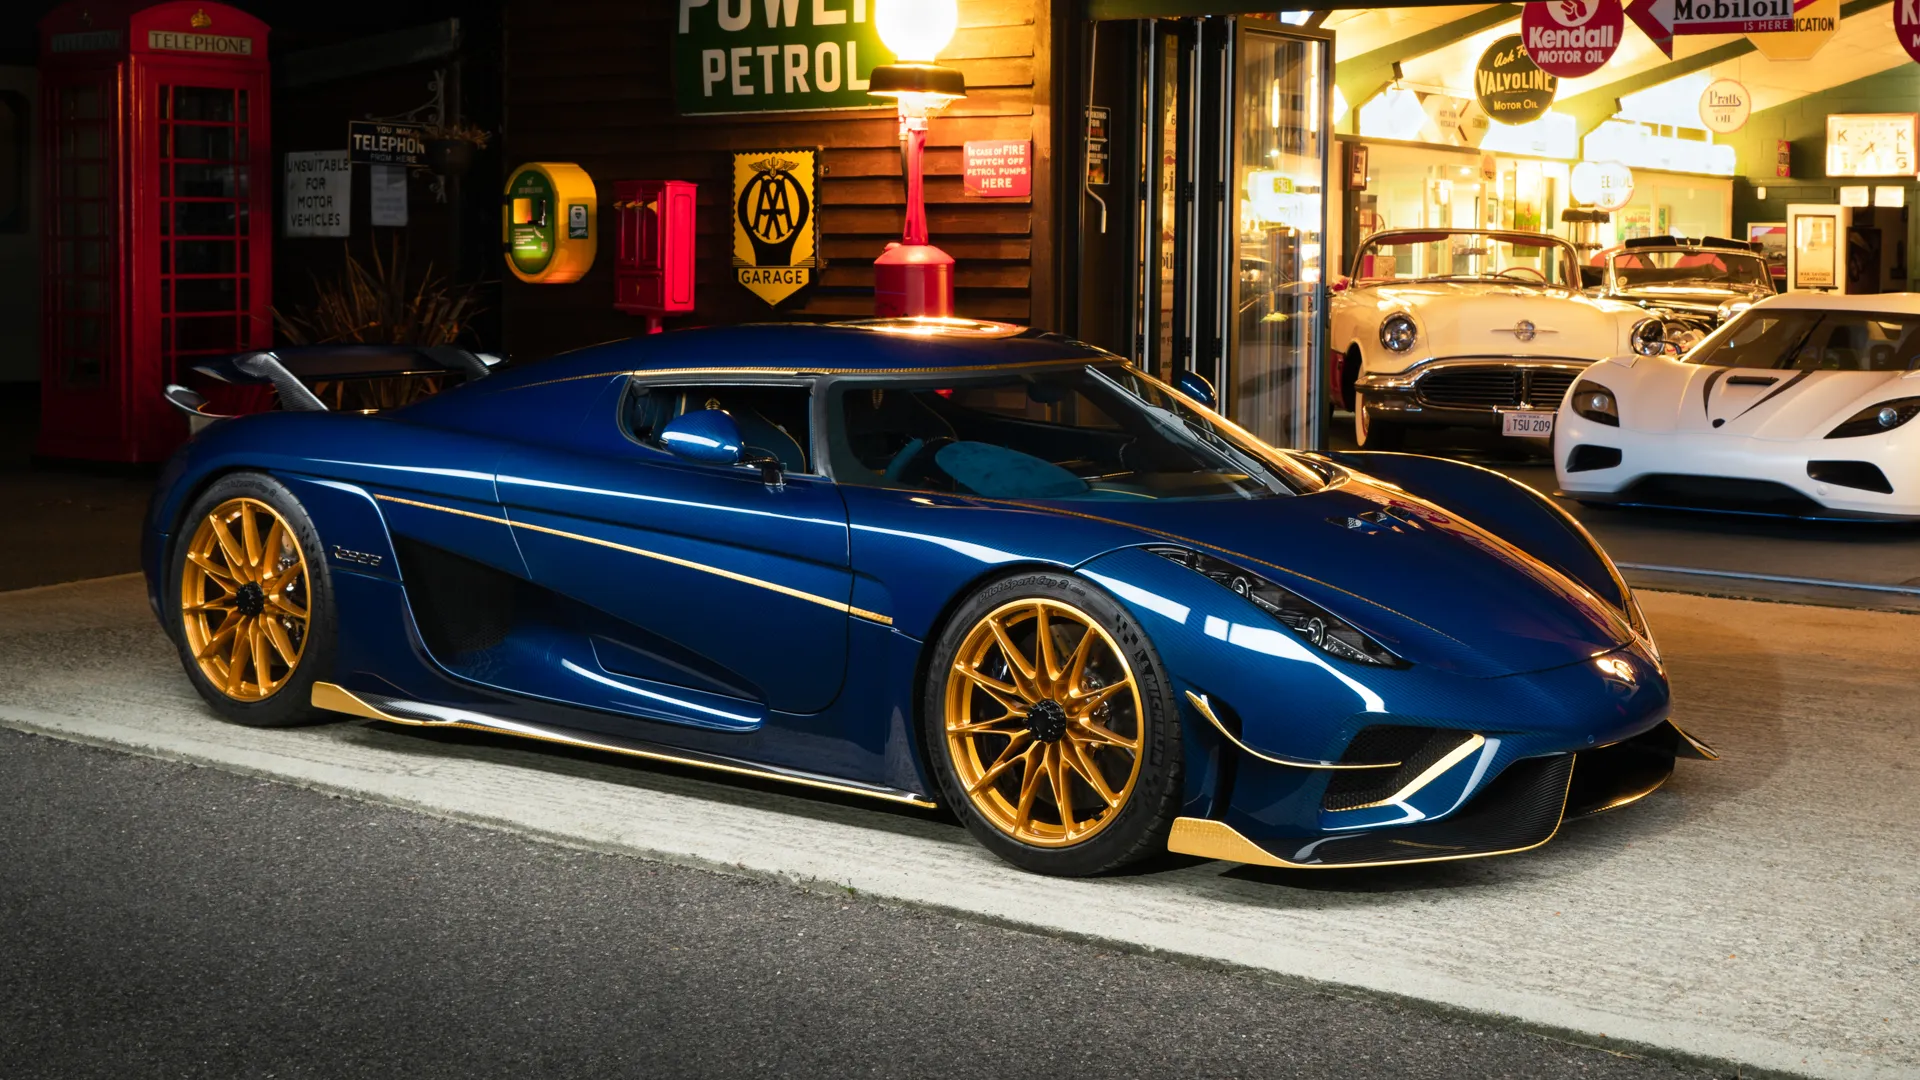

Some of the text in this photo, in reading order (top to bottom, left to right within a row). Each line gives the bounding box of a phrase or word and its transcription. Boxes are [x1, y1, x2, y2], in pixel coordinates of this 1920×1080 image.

[678, 0, 867, 34] POW
[1673, 0, 1790, 20] Mobiloil
[1744, 20, 1788, 31] IS HERE
[152, 33, 249, 53] TELEPHONE
[1529, 25, 1614, 48] Kendall
[1494, 45, 1528, 68] Ask Fo
[1537, 50, 1604, 63] MOTOR OIL
[702, 41, 871, 97] PETROL
[1478, 69, 1553, 97] VALVOLINE
[1709, 90, 1742, 108] Pratts
[1715, 115, 1733, 123] OIL
[376, 126, 392, 134] YOU
[353, 134, 425, 154] TELEPHON
[1003, 144, 1025, 156] FIRE
[370, 153, 417, 163] FROM HERE
[970, 157, 1024, 166] SWITCH OFF
[287, 159, 349, 172] UNSUITABLE
[967, 167, 1026, 176] PETROL PUMPS
[306, 178, 326, 190] FOR
[982, 178, 1013, 189] HERE
[298, 196, 333, 208] MOTOR
[291, 213, 341, 227] VEHICLES
[741, 270, 803, 284] GARAGE
[1513, 418, 1551, 432] TSU 209
[1003, 576, 1036, 591] Sport
[1036, 576, 1058, 588] Cup
[1144, 673, 1165, 767] MICHELIN
